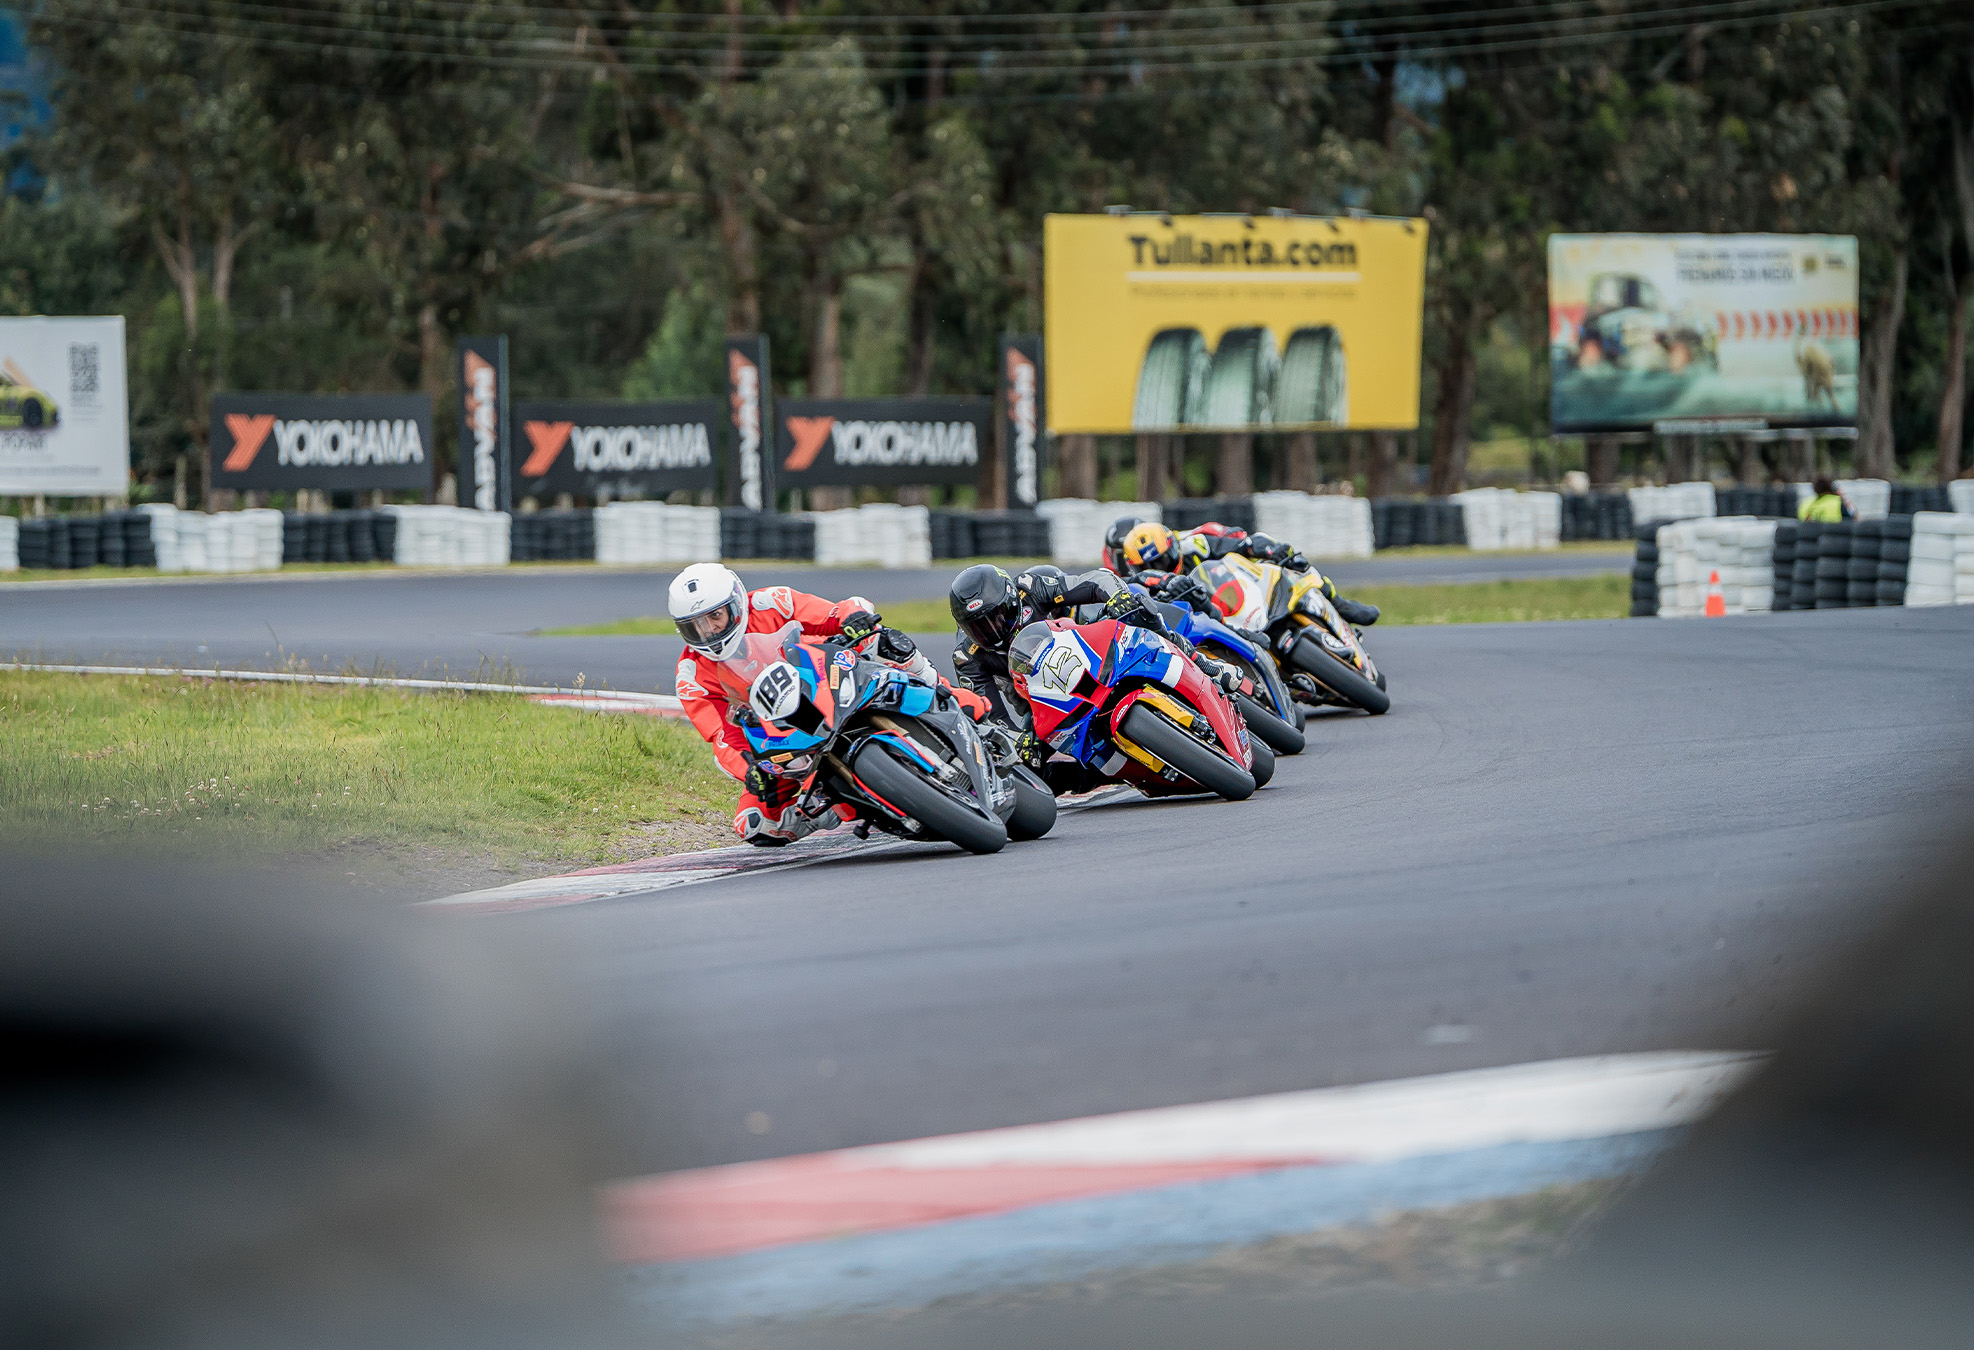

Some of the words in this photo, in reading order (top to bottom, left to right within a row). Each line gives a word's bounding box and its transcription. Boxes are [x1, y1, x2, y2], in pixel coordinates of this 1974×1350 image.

[1127, 232, 1358, 266] Tullanta.com
[273, 418, 425, 466] YOKOHAMA
[571, 422, 712, 473] YOKOHAMA
[831, 419, 979, 466] YOKOHAMA
[1035, 647, 1051, 671] HONDA
[755, 664, 793, 717] 189
